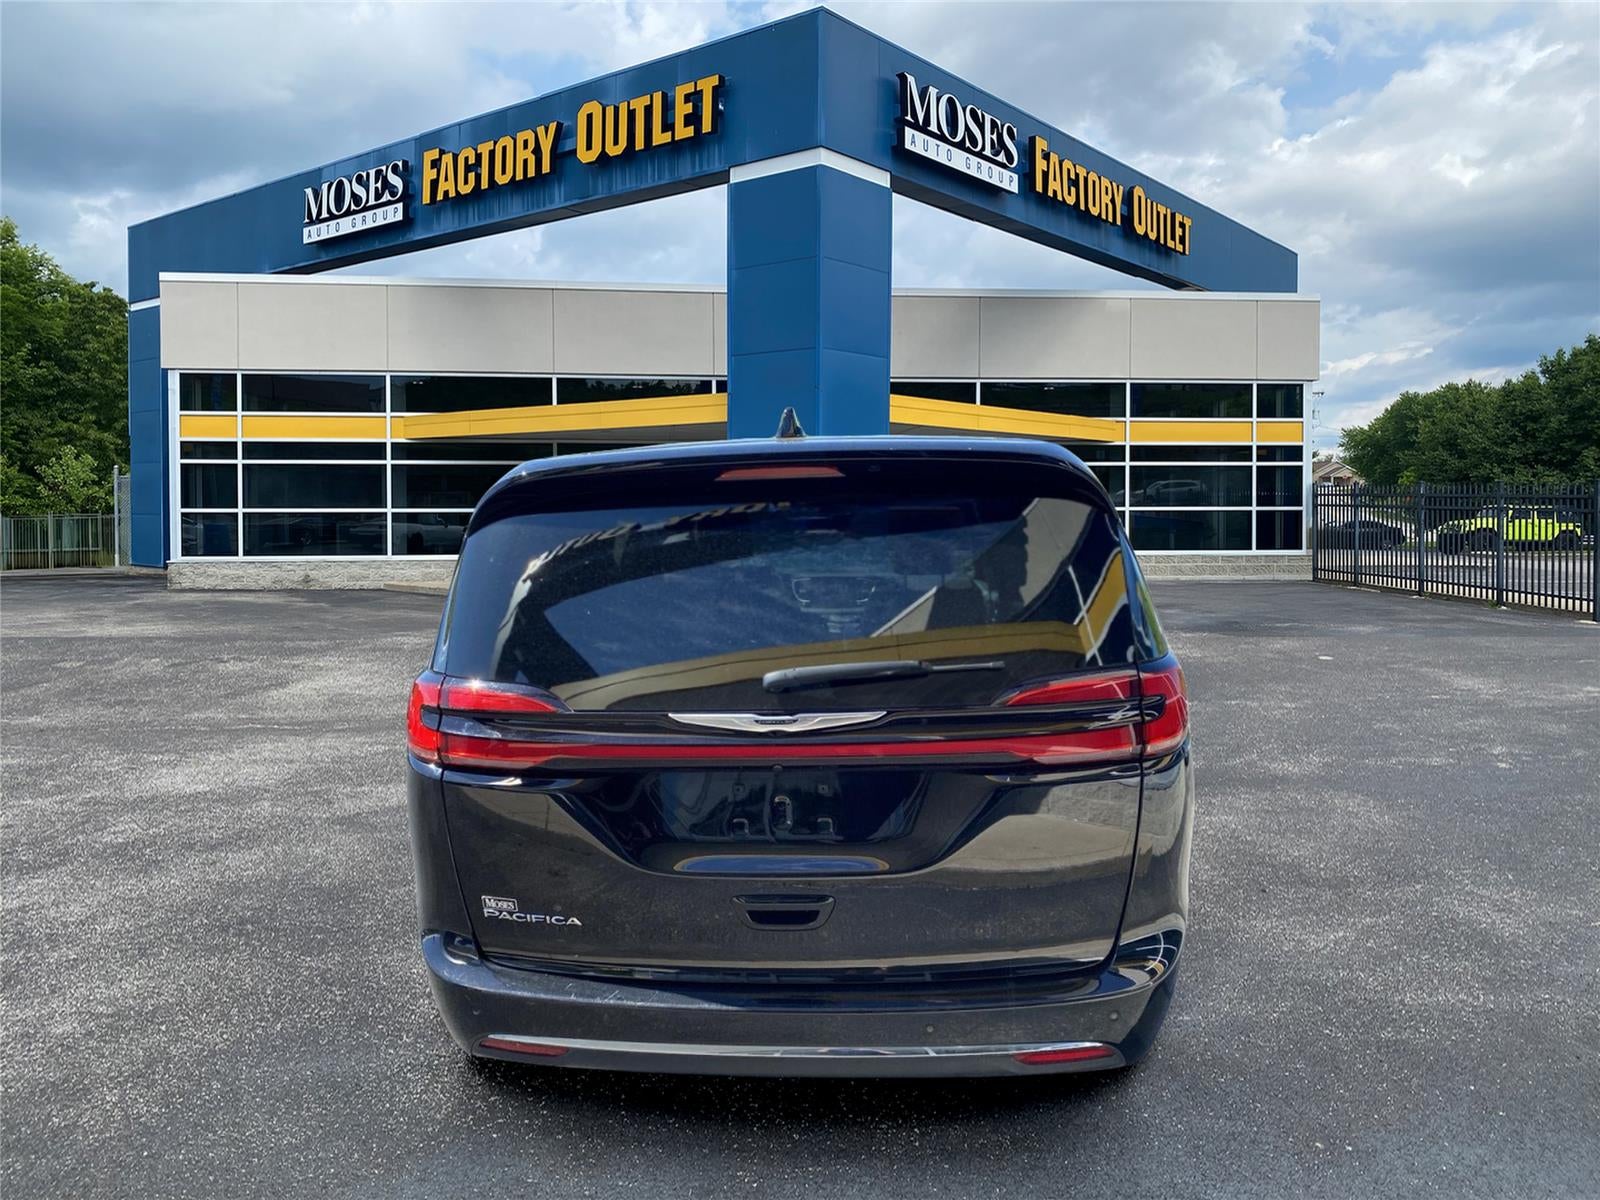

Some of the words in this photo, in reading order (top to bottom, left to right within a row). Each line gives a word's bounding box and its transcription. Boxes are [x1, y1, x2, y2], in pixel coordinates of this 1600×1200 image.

[904, 72, 1019, 168] MOSES
[910, 133, 952, 162] AUTO
[965, 156, 1015, 187] GROUP
[304, 160, 405, 224] MOSES
[307, 223, 341, 240] AUTO
[350, 207, 400, 229] GROUP
[483, 908, 583, 926] PACIFICA
